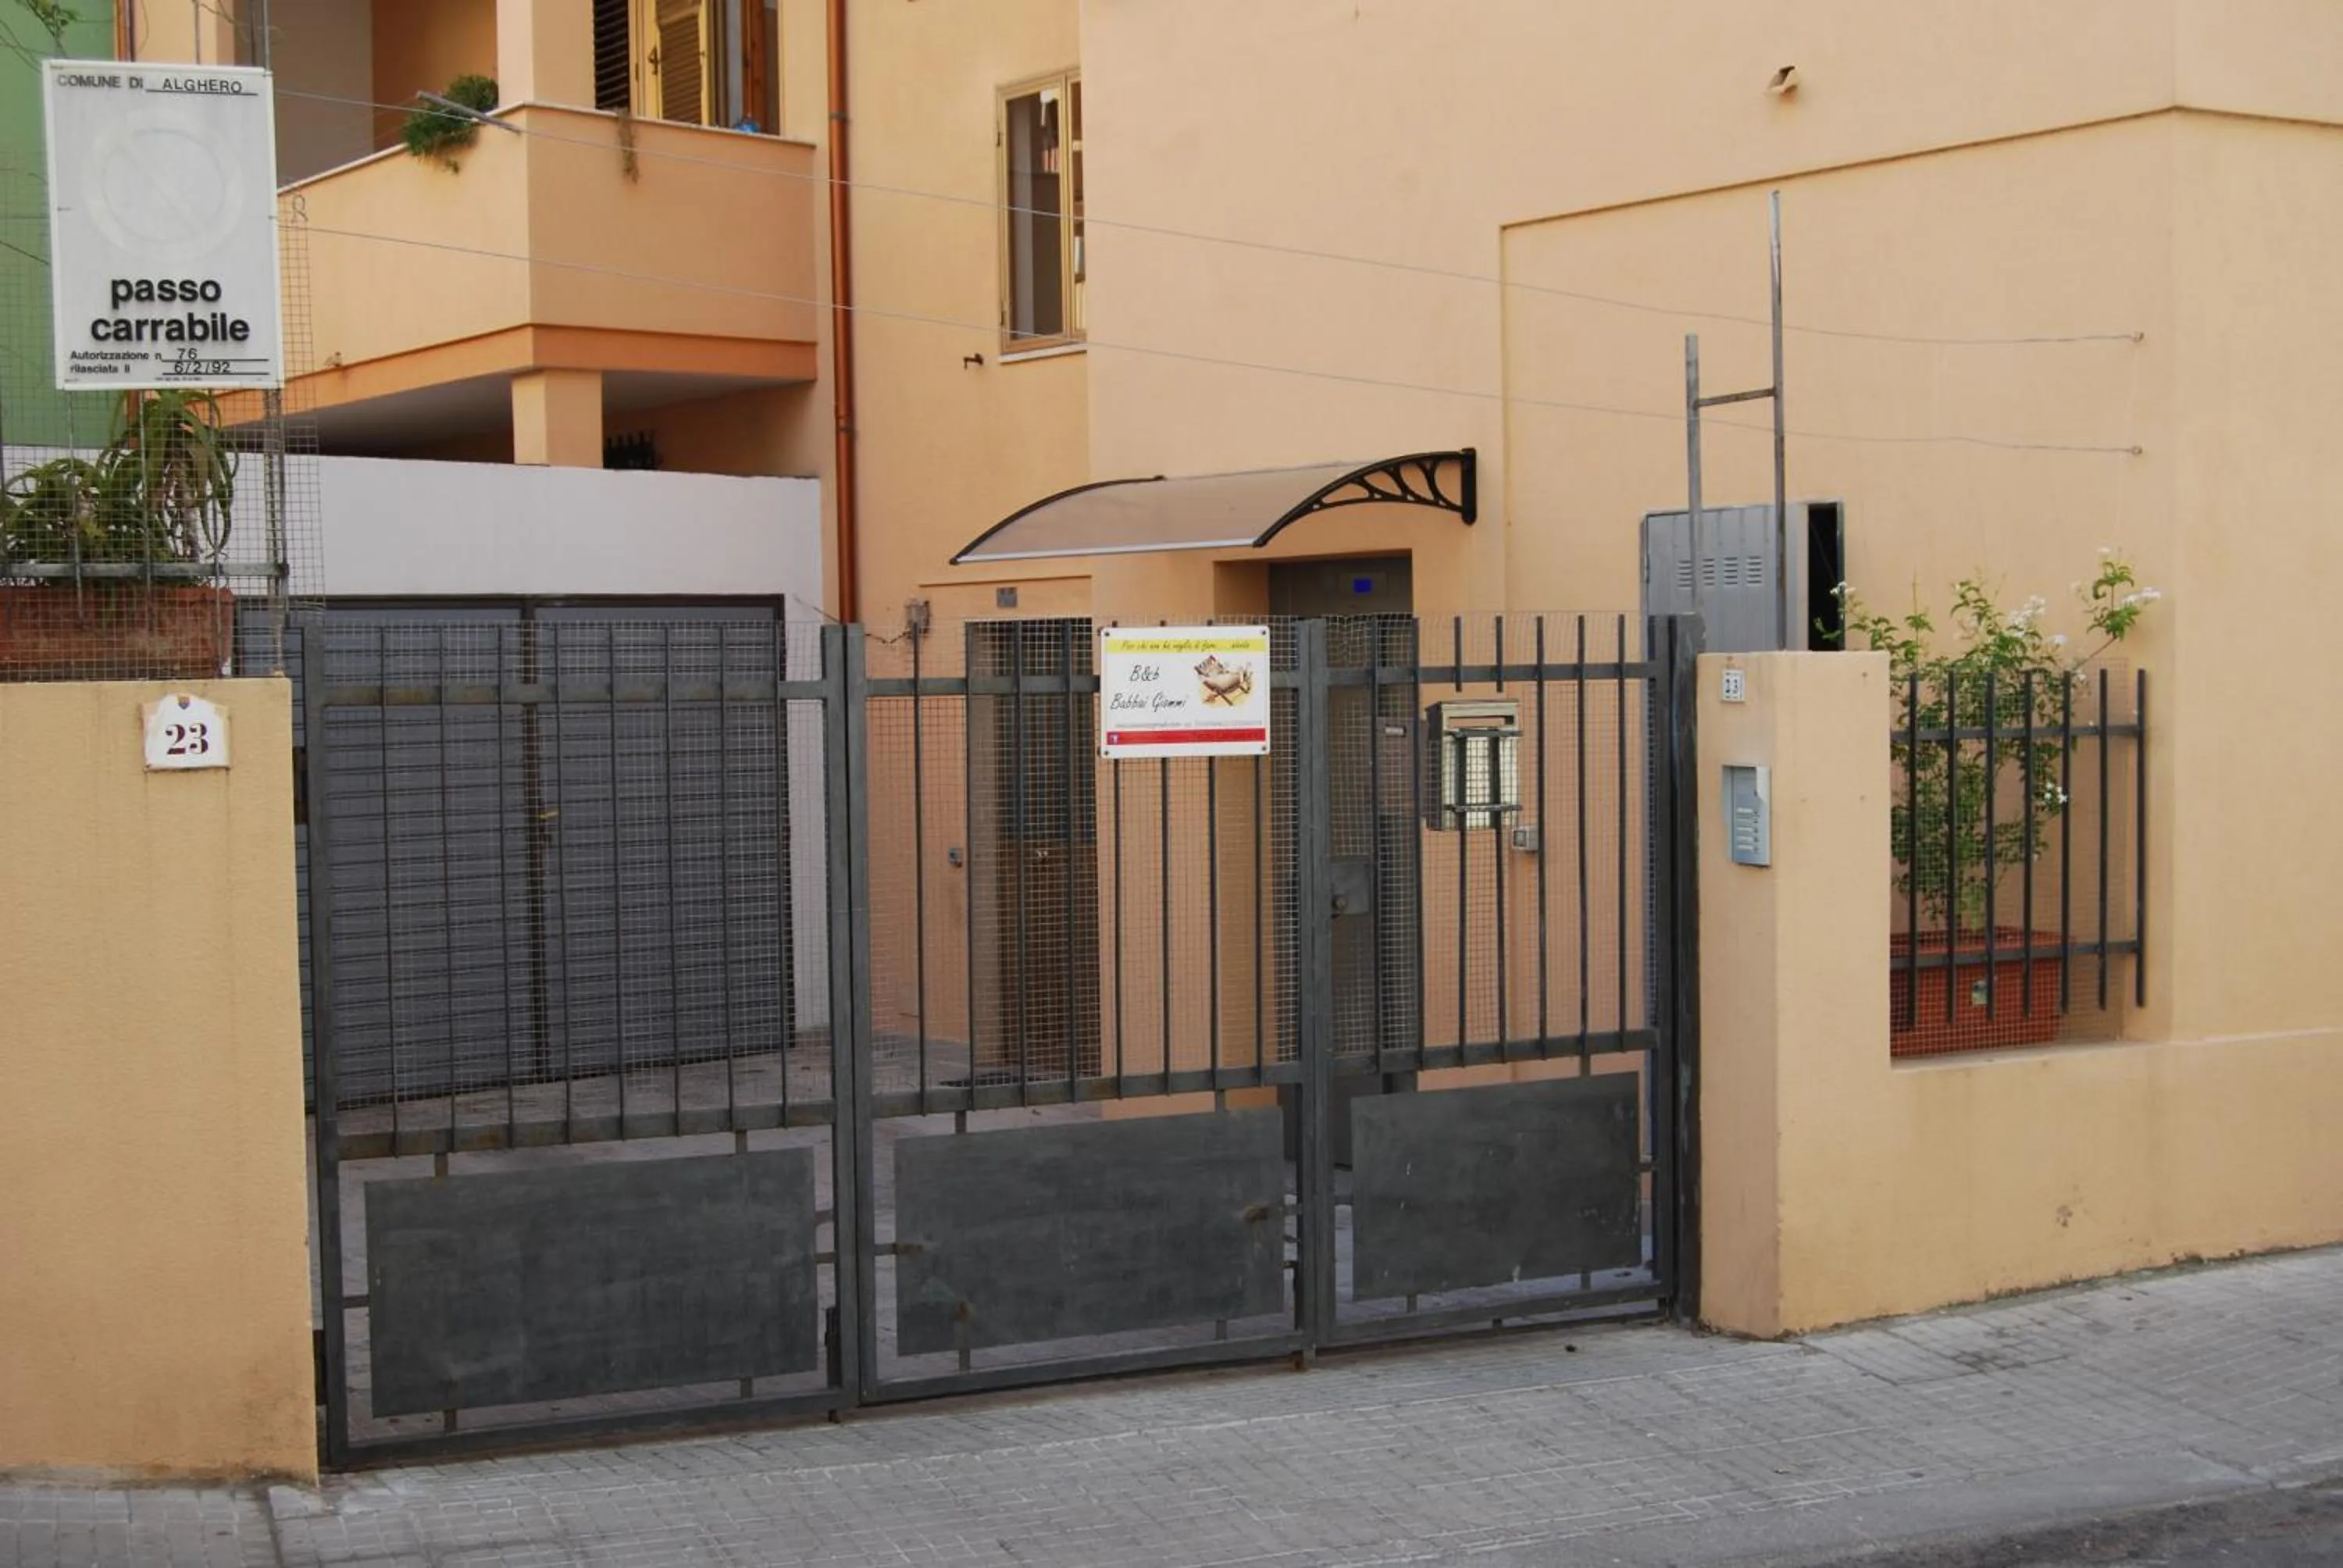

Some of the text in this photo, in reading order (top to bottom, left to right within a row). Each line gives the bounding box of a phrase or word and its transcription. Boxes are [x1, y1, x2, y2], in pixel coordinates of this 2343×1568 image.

[57, 74, 243, 94] COMUNE DI ALGHERO
[111, 278, 222, 310] passo
[91, 312, 251, 342] carrabile
[70, 350, 150, 361] Autorizzazione
[177, 347, 198, 360] 76
[70, 364, 119, 374] rilasciata
[174, 360, 231, 375] 6/2/92
[165, 722, 209, 755] 23
